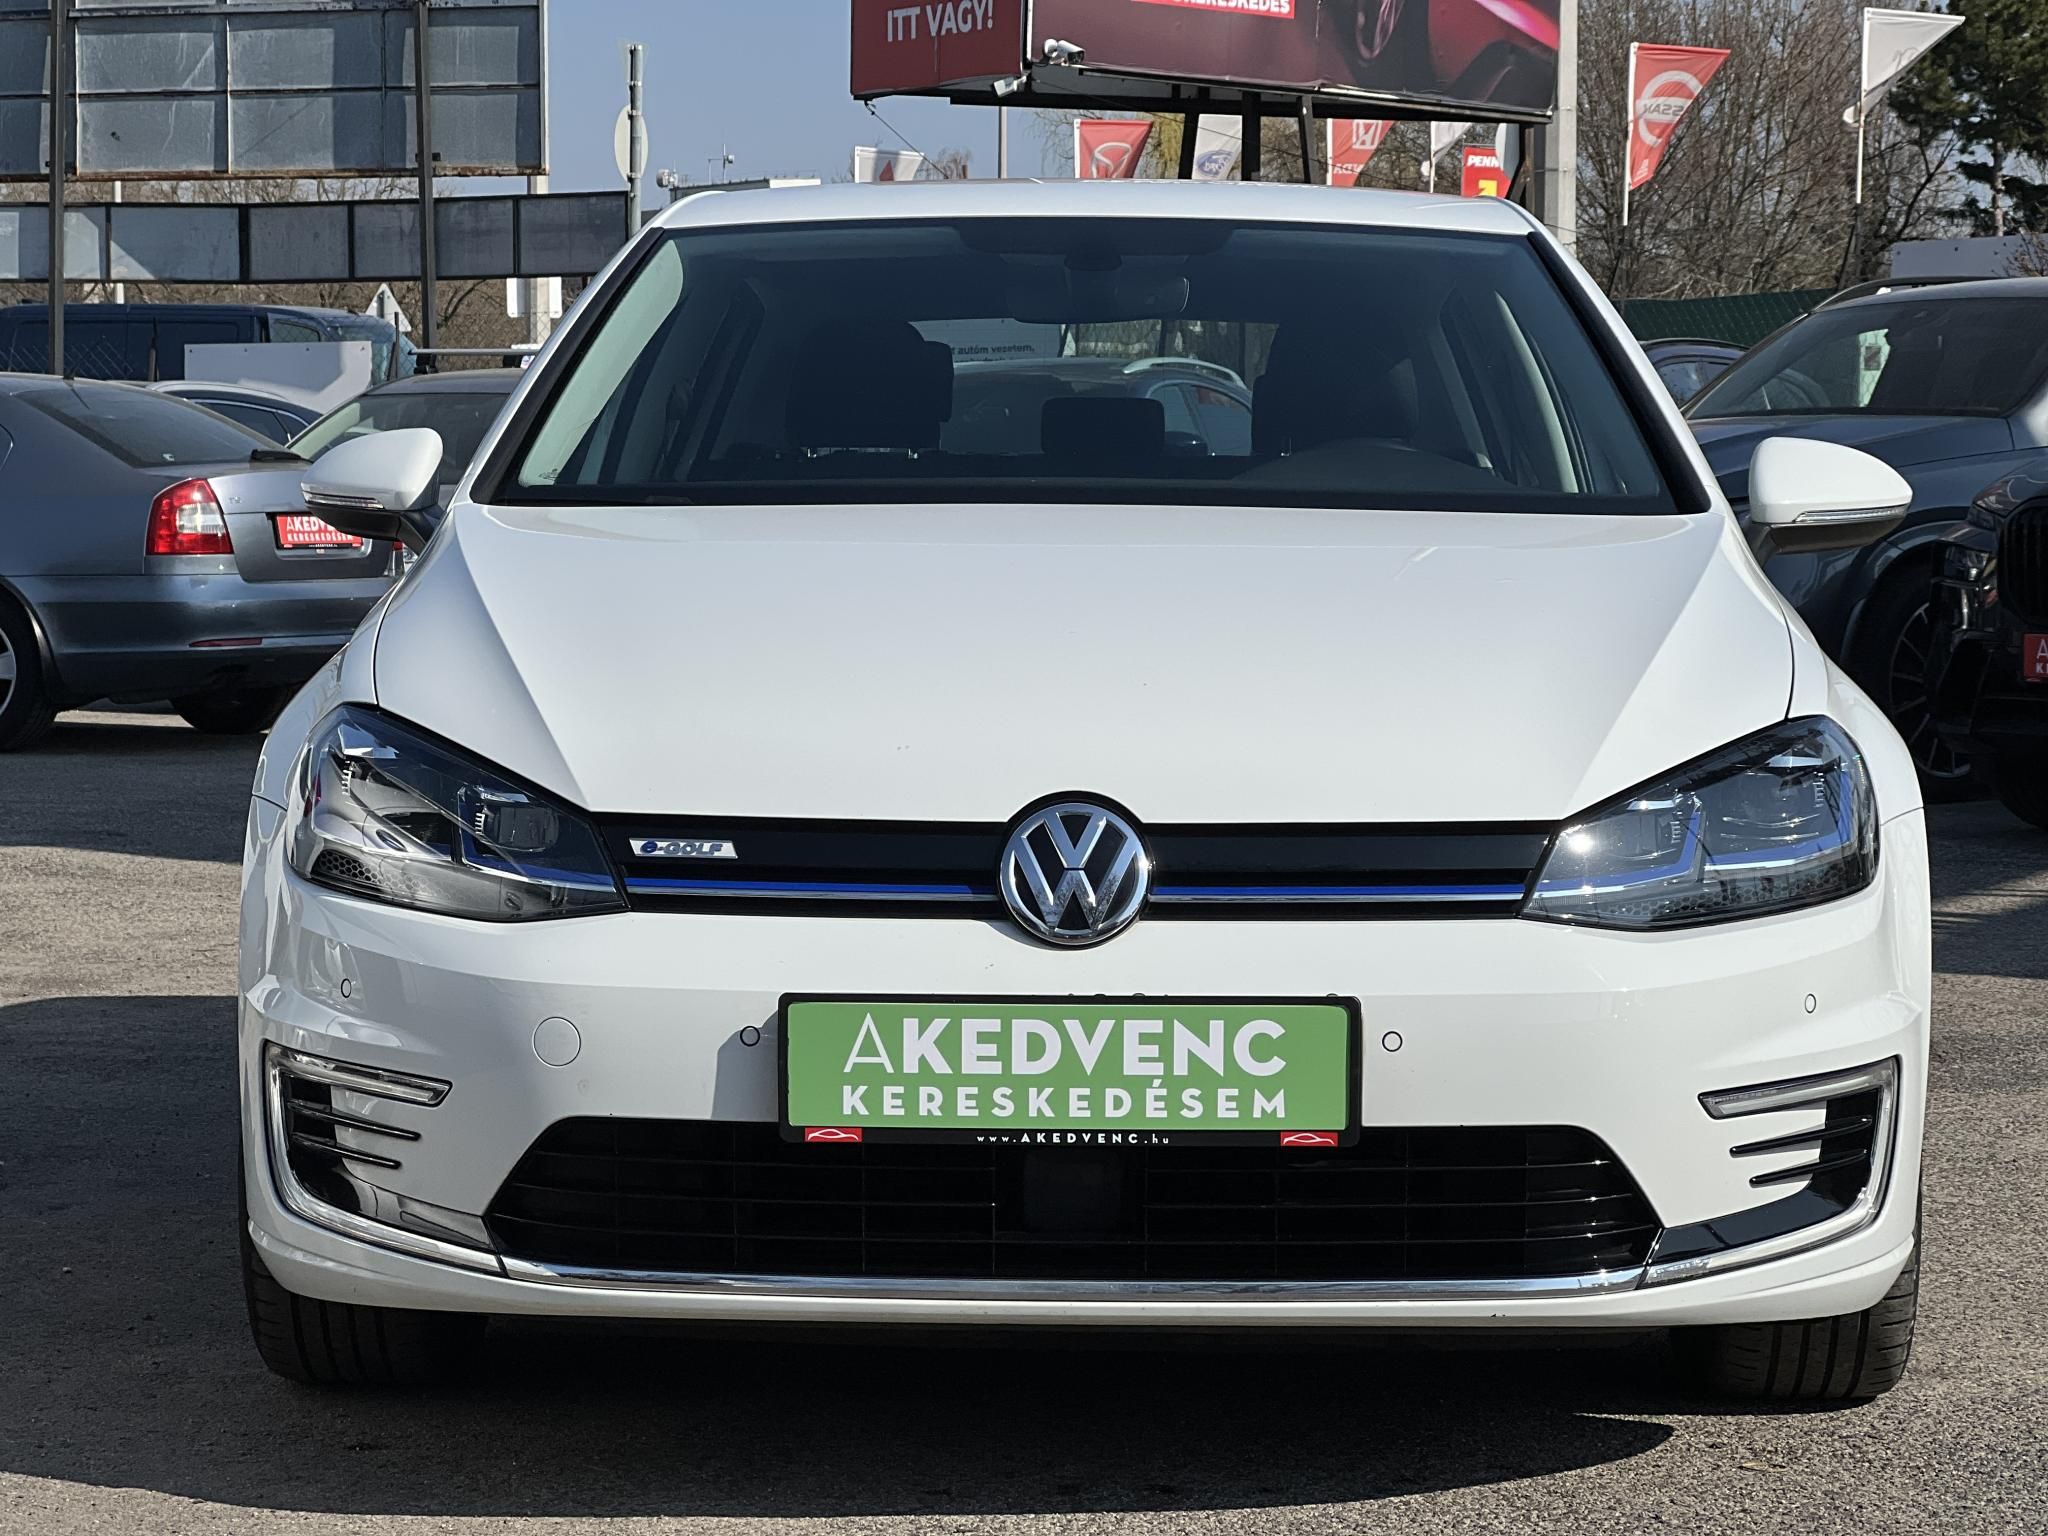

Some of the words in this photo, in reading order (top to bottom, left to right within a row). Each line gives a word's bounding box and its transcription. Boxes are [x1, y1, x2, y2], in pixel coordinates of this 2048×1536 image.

[887, 6, 921, 42] ITT
[926, 0, 993, 37] VAGY!
[1467, 155, 1500, 168] PENN
[843, 1012, 1287, 1077] AKEDVENC
[842, 1078, 1286, 1119] KERESKEDÉSEM
[976, 1132, 1170, 1145] www.AKEDVENC.hu
